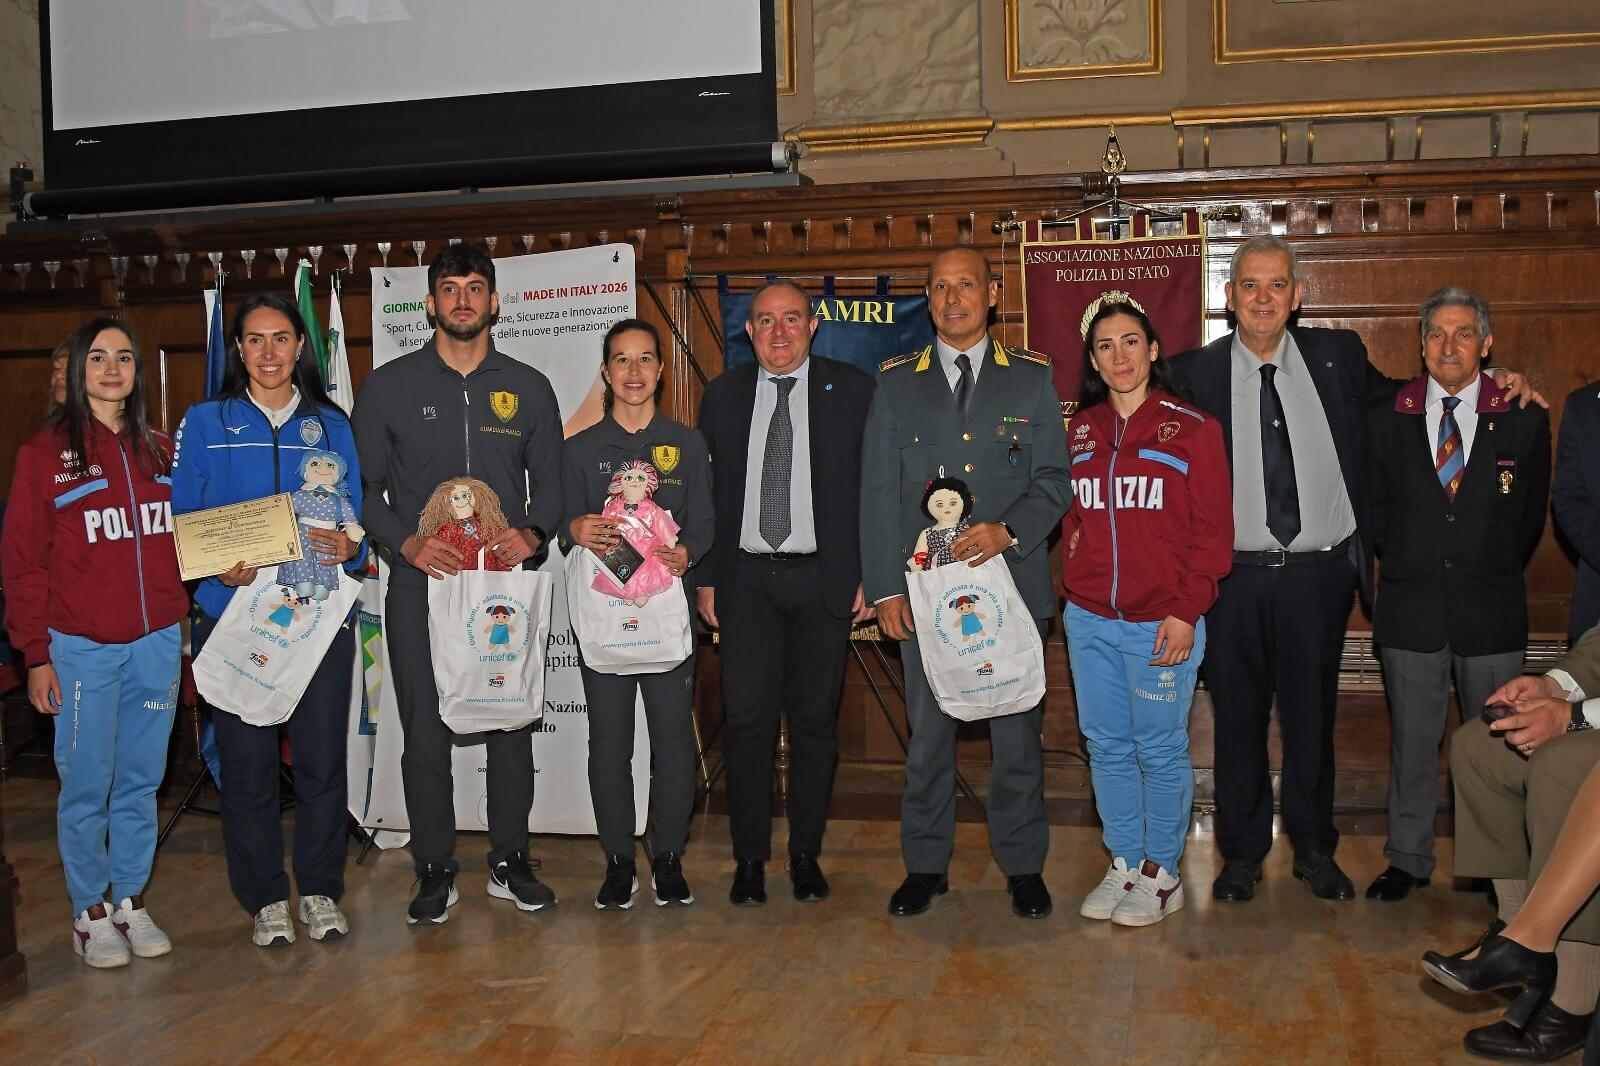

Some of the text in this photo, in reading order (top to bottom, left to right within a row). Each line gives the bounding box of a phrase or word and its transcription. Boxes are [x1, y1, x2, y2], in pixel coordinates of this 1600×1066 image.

[1025, 245, 1201, 265] ASSOCIAZIONE NAZIONALE
[1056, 265, 1170, 282] POLIZIA DI STATO
[523, 289, 555, 302] MADE
[557, 287, 568, 299] IN
[570, 285, 598, 297] ITALY
[601, 282, 628, 294] 2026
[497, 313, 515, 324] ore,
[517, 309, 560, 322] Sicurezza
[562, 310, 568, 318] e
[570, 304, 629, 318] Innovazione
[811, 300, 896, 324] AMRI
[399, 337, 407, 347] al
[498, 328, 520, 340] delle
[522, 327, 551, 338] nuove
[84, 501, 172, 543] POLIZI
[250, 625, 280, 643] unicef
[479, 652, 507, 663] unicef
[957, 639, 986, 657] unicef
[1135, 688, 1165, 701] Allianz
